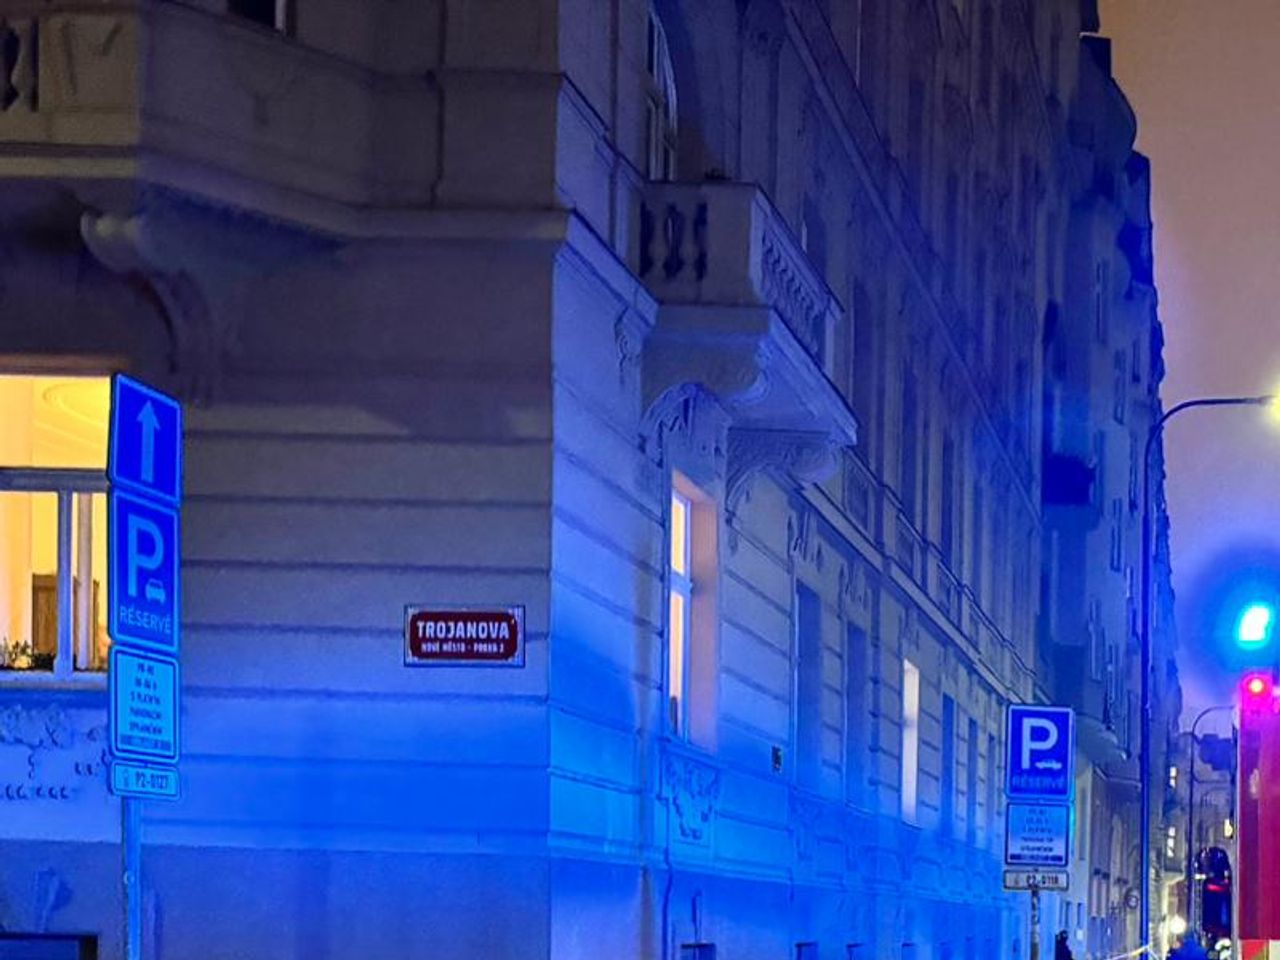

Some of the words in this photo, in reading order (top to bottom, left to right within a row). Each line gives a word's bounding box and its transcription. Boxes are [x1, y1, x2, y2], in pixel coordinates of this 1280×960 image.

[128, 514, 164, 597] P
[119, 604, 172, 634] RÉSERVÉ
[416, 620, 510, 639] TROJANOVA
[473, 642, 498, 654] PRAHA
[1021, 717, 1059, 770] P
